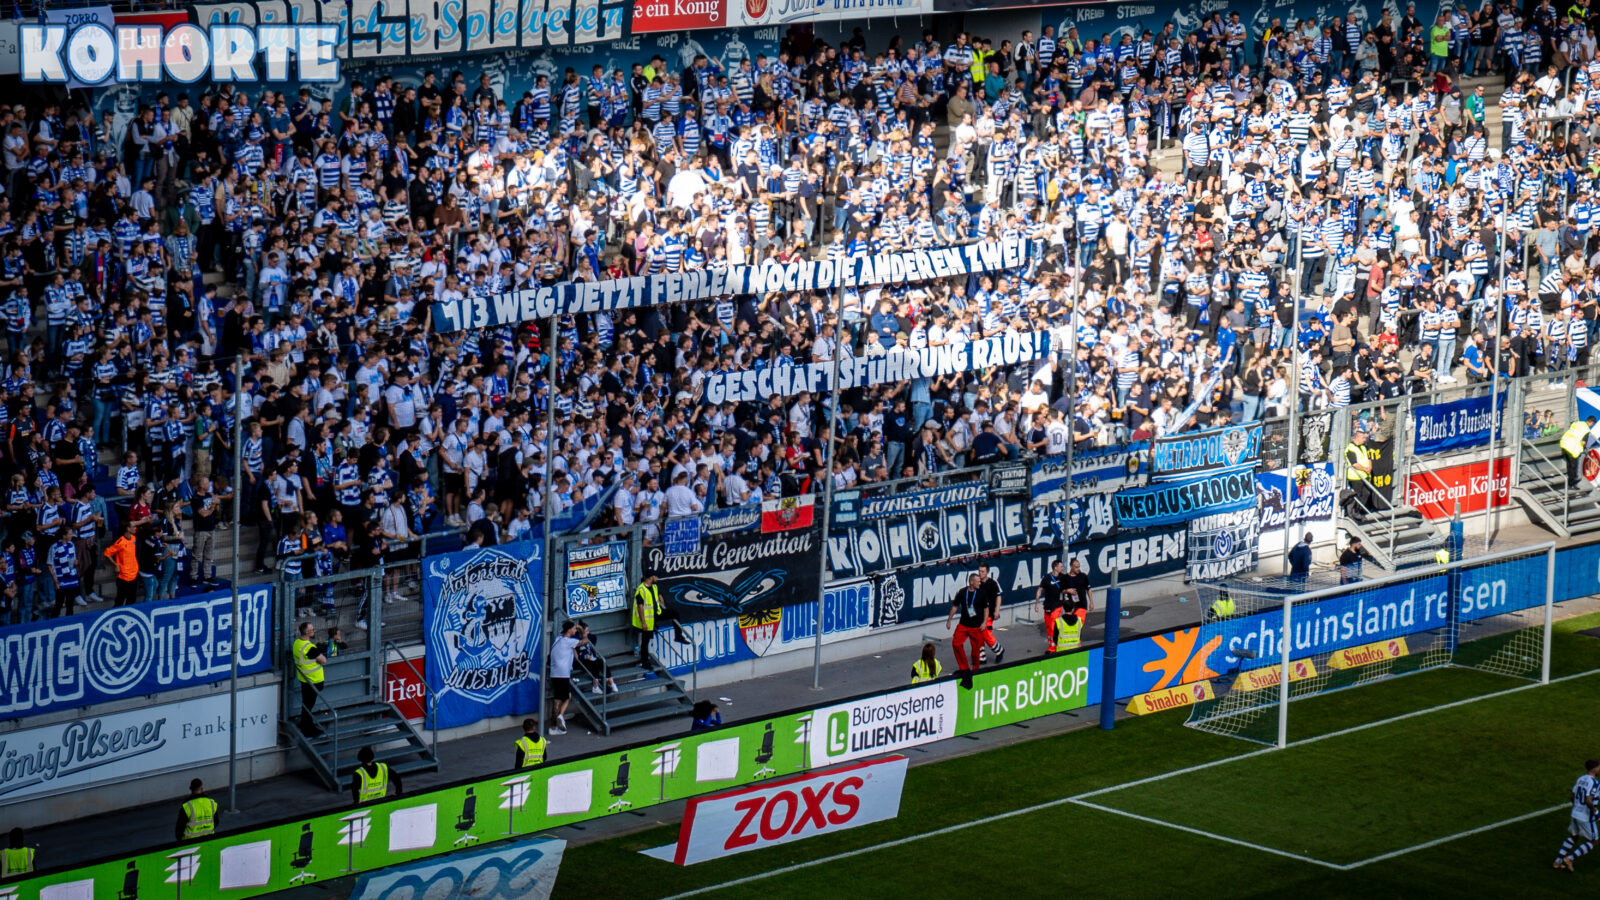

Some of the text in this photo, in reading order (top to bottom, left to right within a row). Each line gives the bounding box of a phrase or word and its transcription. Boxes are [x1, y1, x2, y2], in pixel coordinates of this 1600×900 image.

[65, 13, 99, 26] ZORRO
[439, 0, 623, 50] Spielveren
[650, 3, 669, 17] ein
[494, 284, 565, 324] WEG!
[568, 276, 646, 313] JETZT
[649, 266, 745, 305] FEHLEN
[749, 260, 816, 293] NOCH
[817, 256, 856, 288] DIE
[859, 244, 965, 287] ANDEREN
[973, 330, 1041, 370] RAUS!
[1419, 414, 1447, 441] Block
[1459, 408, 1501, 434] Duisbug
[1115, 469, 1256, 521] WEDAUSTADION
[1409, 487, 1445, 507] Heute
[649, 532, 812, 573] Proud Generation
[913, 566, 1003, 608] IMMR
[1098, 530, 1187, 573] GEBEN!
[1191, 553, 1252, 579] KANAKEN
[1425, 579, 1506, 622] resen
[150, 589, 268, 685] TREU
[1343, 644, 1384, 667] Sinalco
[852, 694, 945, 727] Bürosysteme
[974, 666, 1089, 719] IHR BÜROP
[1144, 690, 1188, 712] Sinalco
[61, 717, 167, 766] Pilsener
[182, 712, 268, 740] Fankrve
[851, 716, 937, 752] LILIENTHAL
[724, 775, 864, 851] ZOXS
